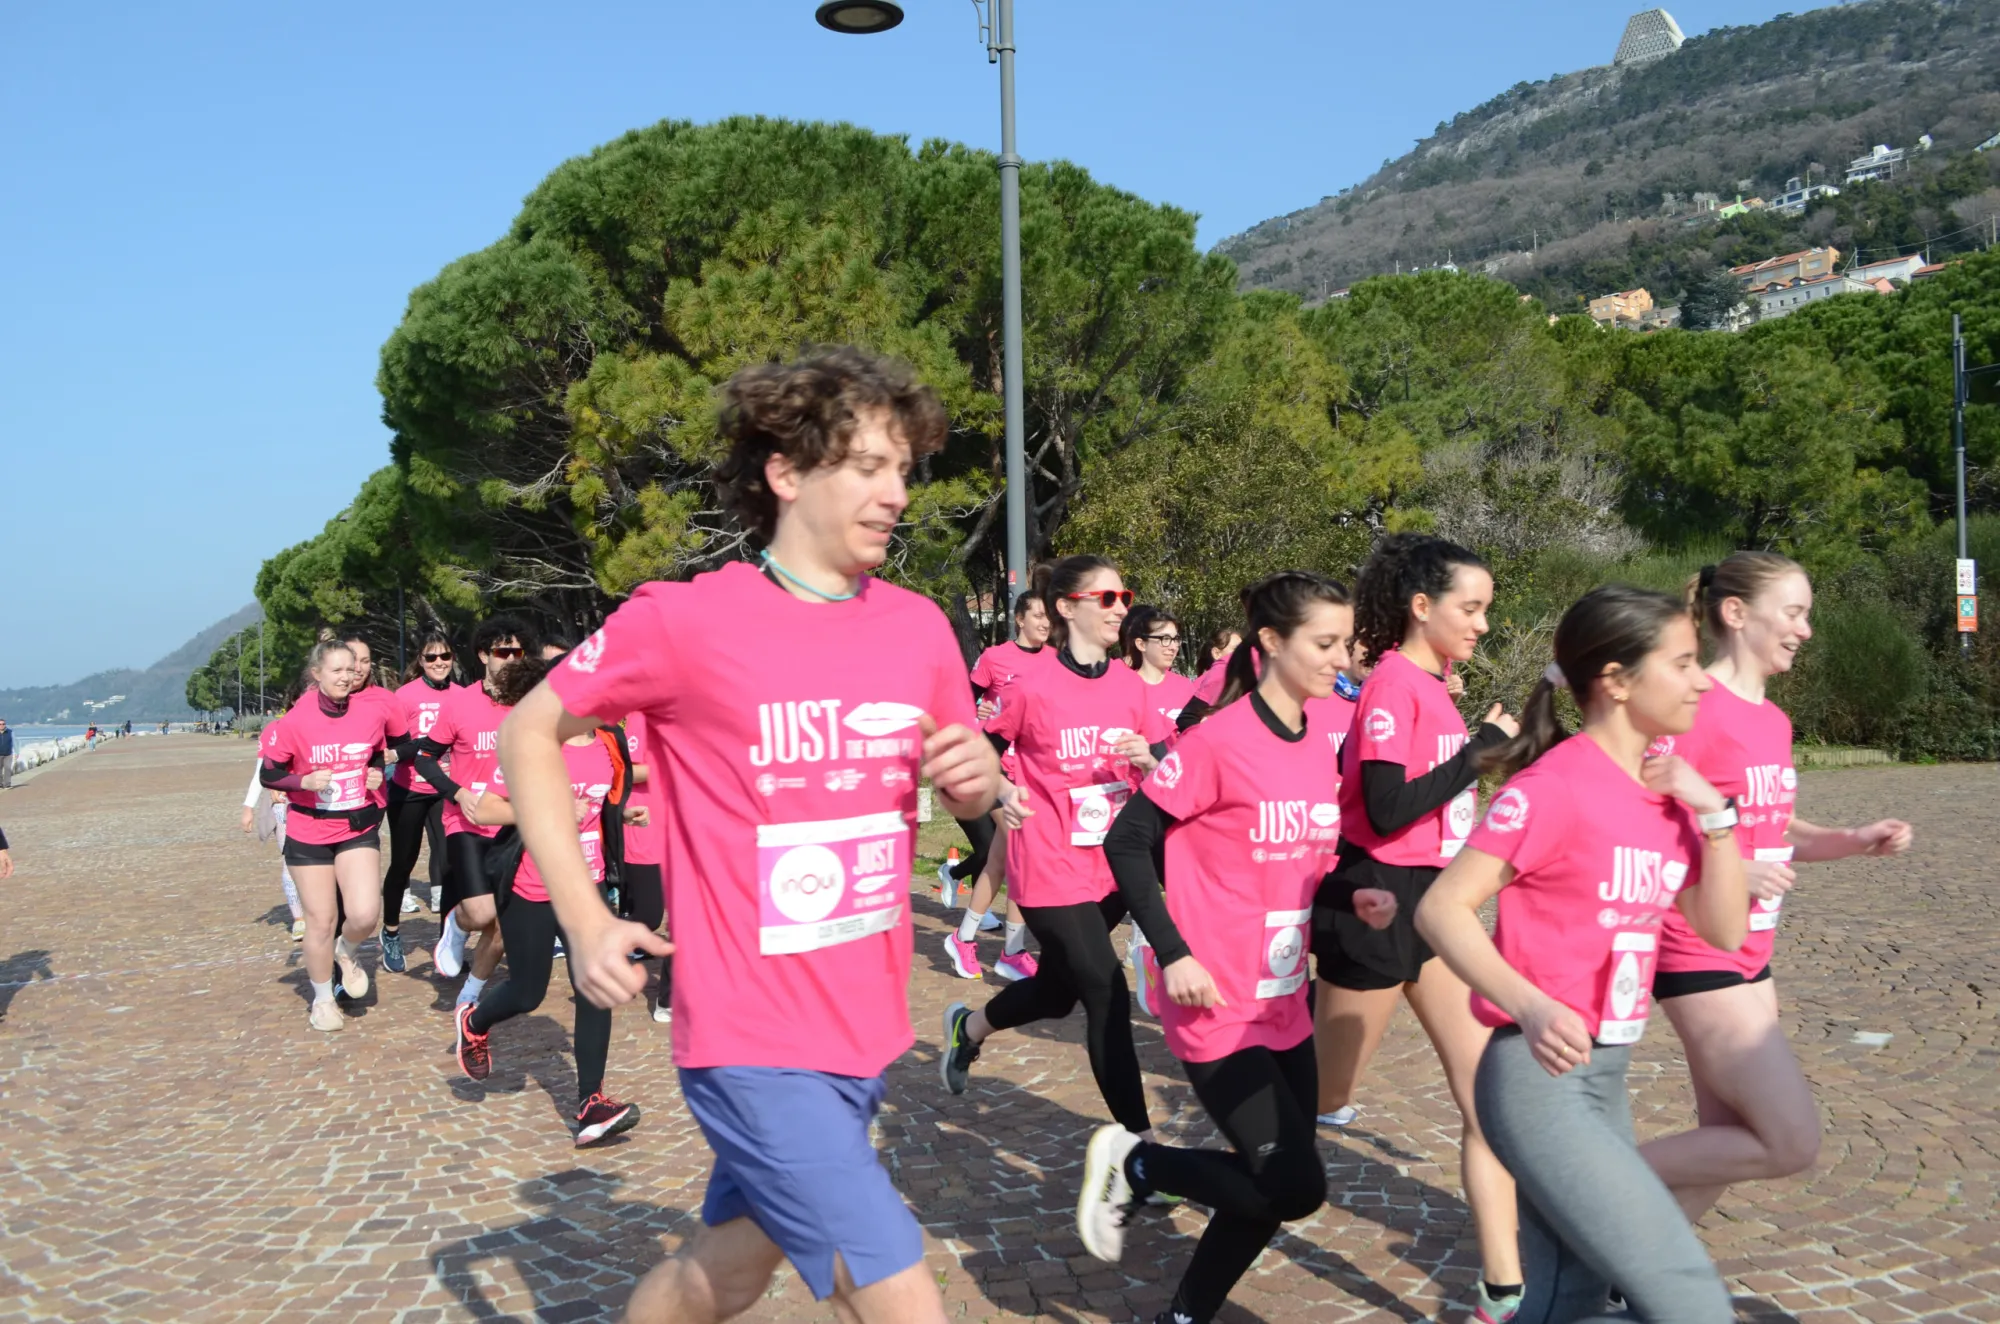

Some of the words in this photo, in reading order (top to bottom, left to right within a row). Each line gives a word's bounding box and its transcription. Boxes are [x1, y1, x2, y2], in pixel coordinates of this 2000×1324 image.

[473, 731, 498, 751] JUS
[749, 699, 841, 766] JUST
[1056, 726, 1100, 760] JUST
[309, 744, 341, 764] JUST
[1737, 764, 1780, 807] JUST
[1249, 800, 1307, 843] JUST
[852, 838, 896, 875] JUST
[1598, 845, 1662, 904] JUST
